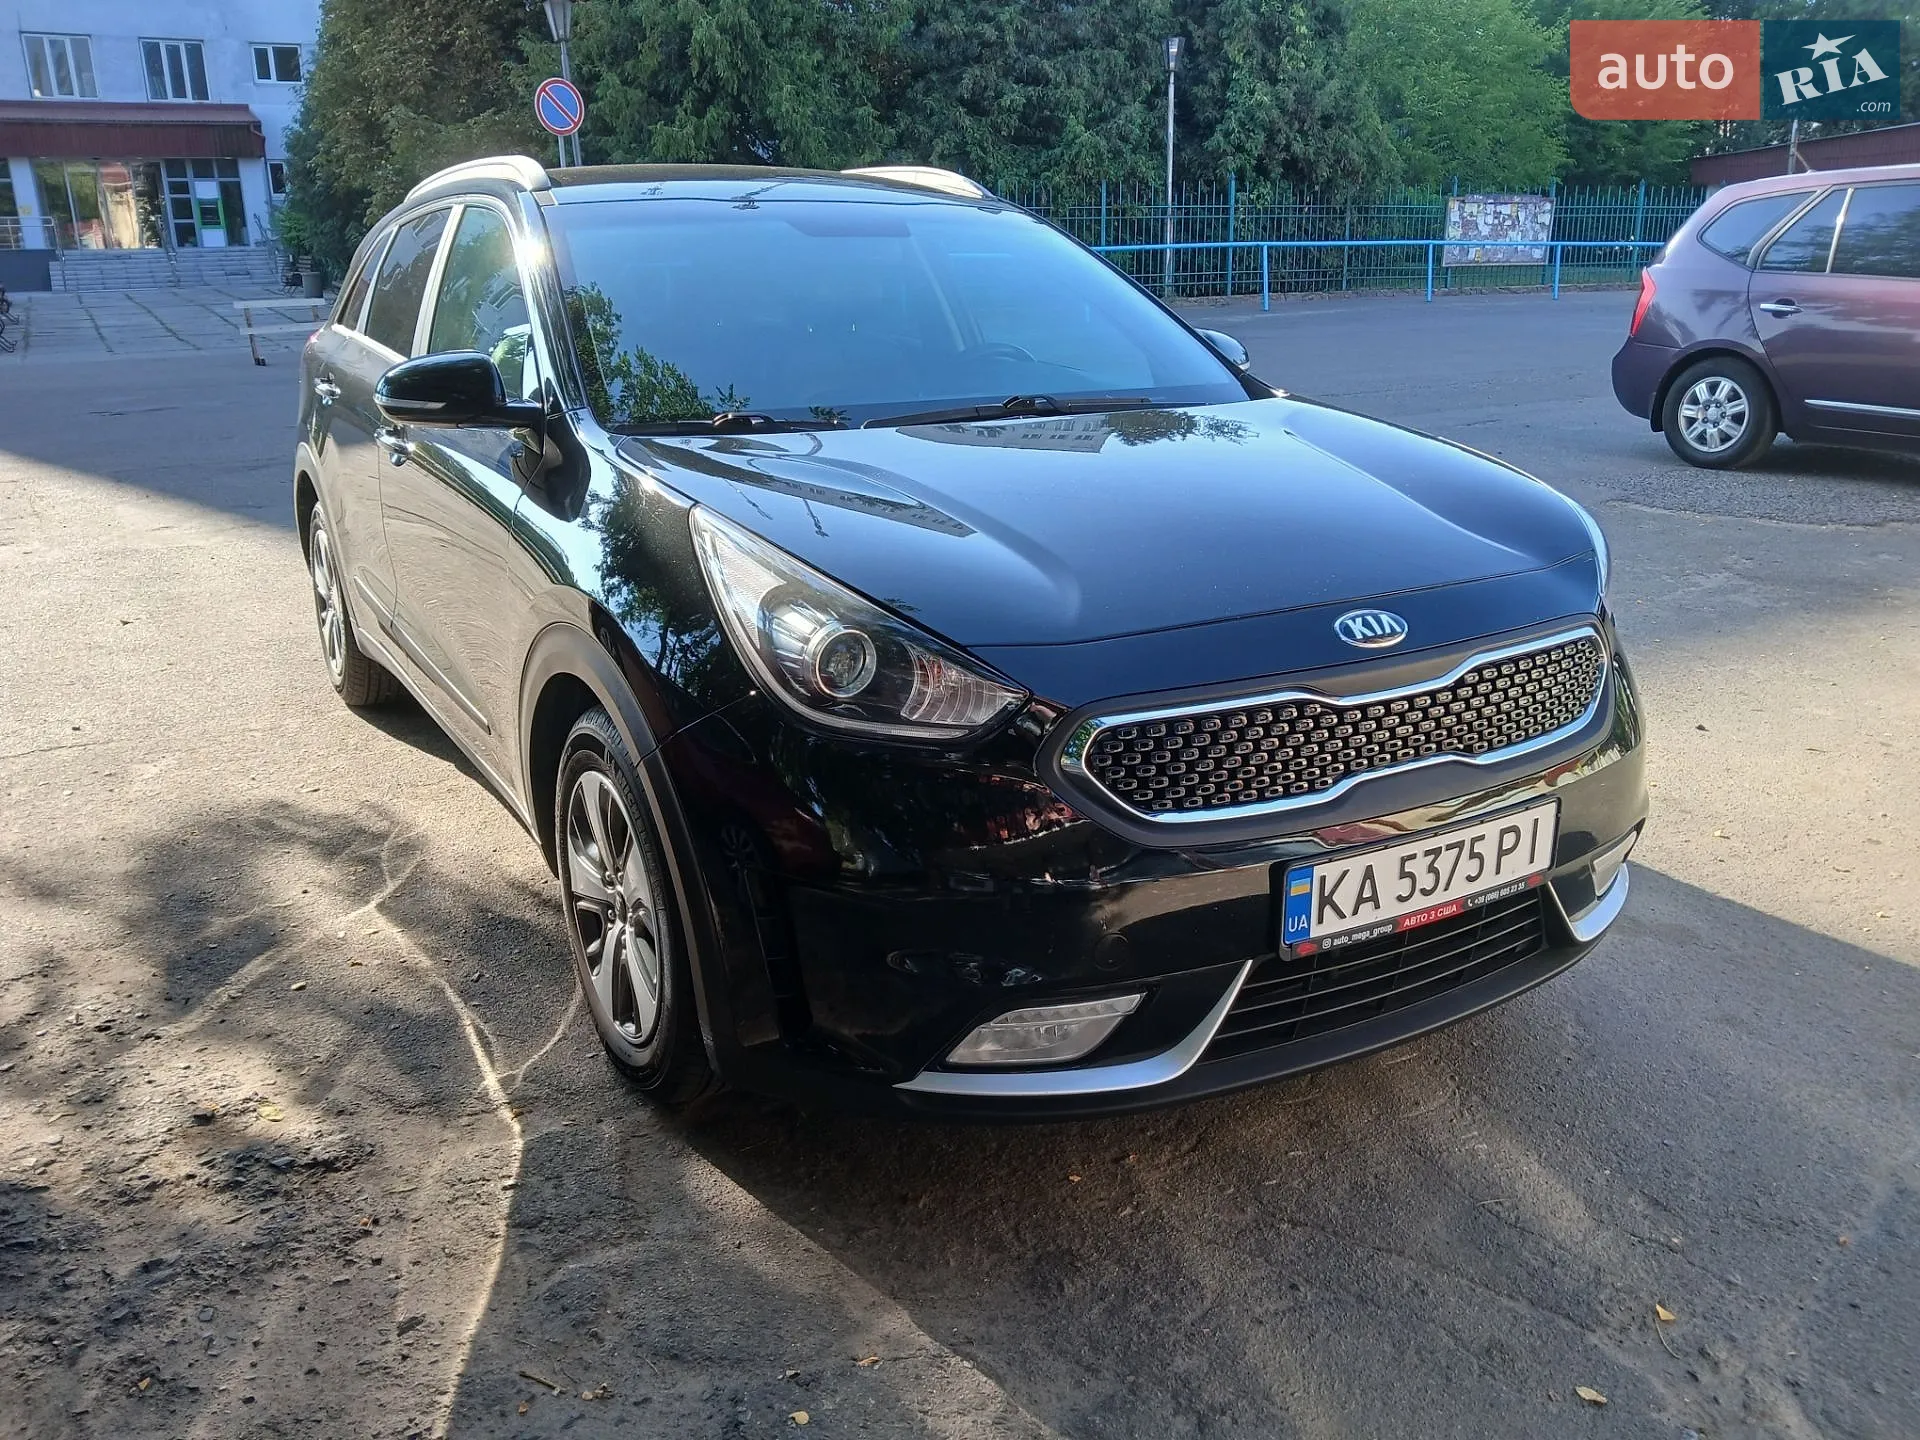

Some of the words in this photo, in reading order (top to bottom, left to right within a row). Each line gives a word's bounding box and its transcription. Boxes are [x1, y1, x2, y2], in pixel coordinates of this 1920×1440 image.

[1344, 614, 1402, 639] KIA
[1317, 864, 1381, 925] KA
[1395, 833, 1486, 903] 5375
[1288, 914, 1308, 932] UA
[1403, 913, 1428, 927] АВТО
[1437, 904, 1457, 917] США
